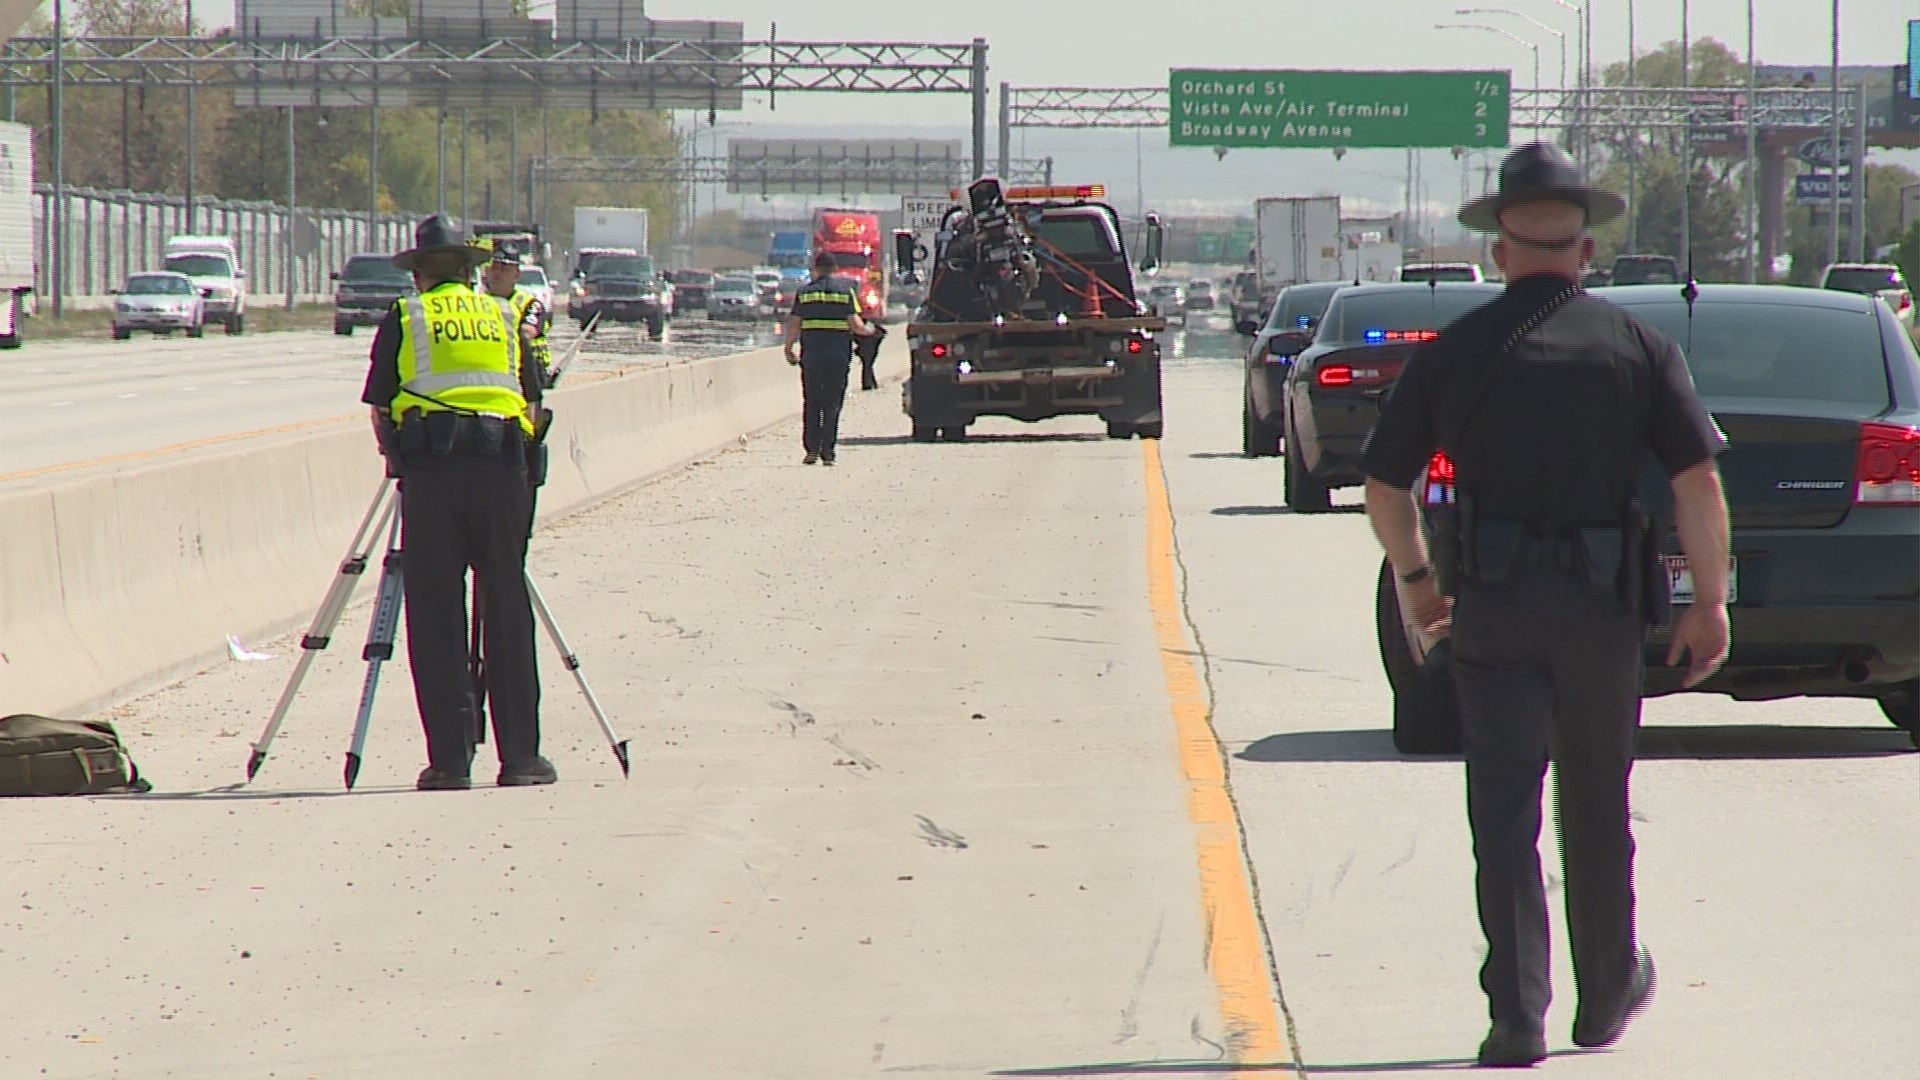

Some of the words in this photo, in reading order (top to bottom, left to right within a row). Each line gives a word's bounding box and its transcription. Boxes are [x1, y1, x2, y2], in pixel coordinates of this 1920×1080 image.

[1181, 80, 1255, 96] Orchard
[1264, 81, 1286, 96] St
[1474, 80, 1499, 97] 1/2
[1181, 101, 1230, 117] Vista
[1239, 99, 1316, 119] Ave/Air
[1327, 101, 1410, 117] Terminal
[1475, 102, 1487, 117] 2
[1181, 122, 1271, 140] Broadway
[1283, 122, 1353, 137] Avenue
[1476, 123, 1487, 137] 3
[912, 216, 941, 229] LIMI
[431, 296, 493, 315] STATE
[433, 319, 501, 343] POLICE
[1777, 481, 1845, 489] CHARGER
